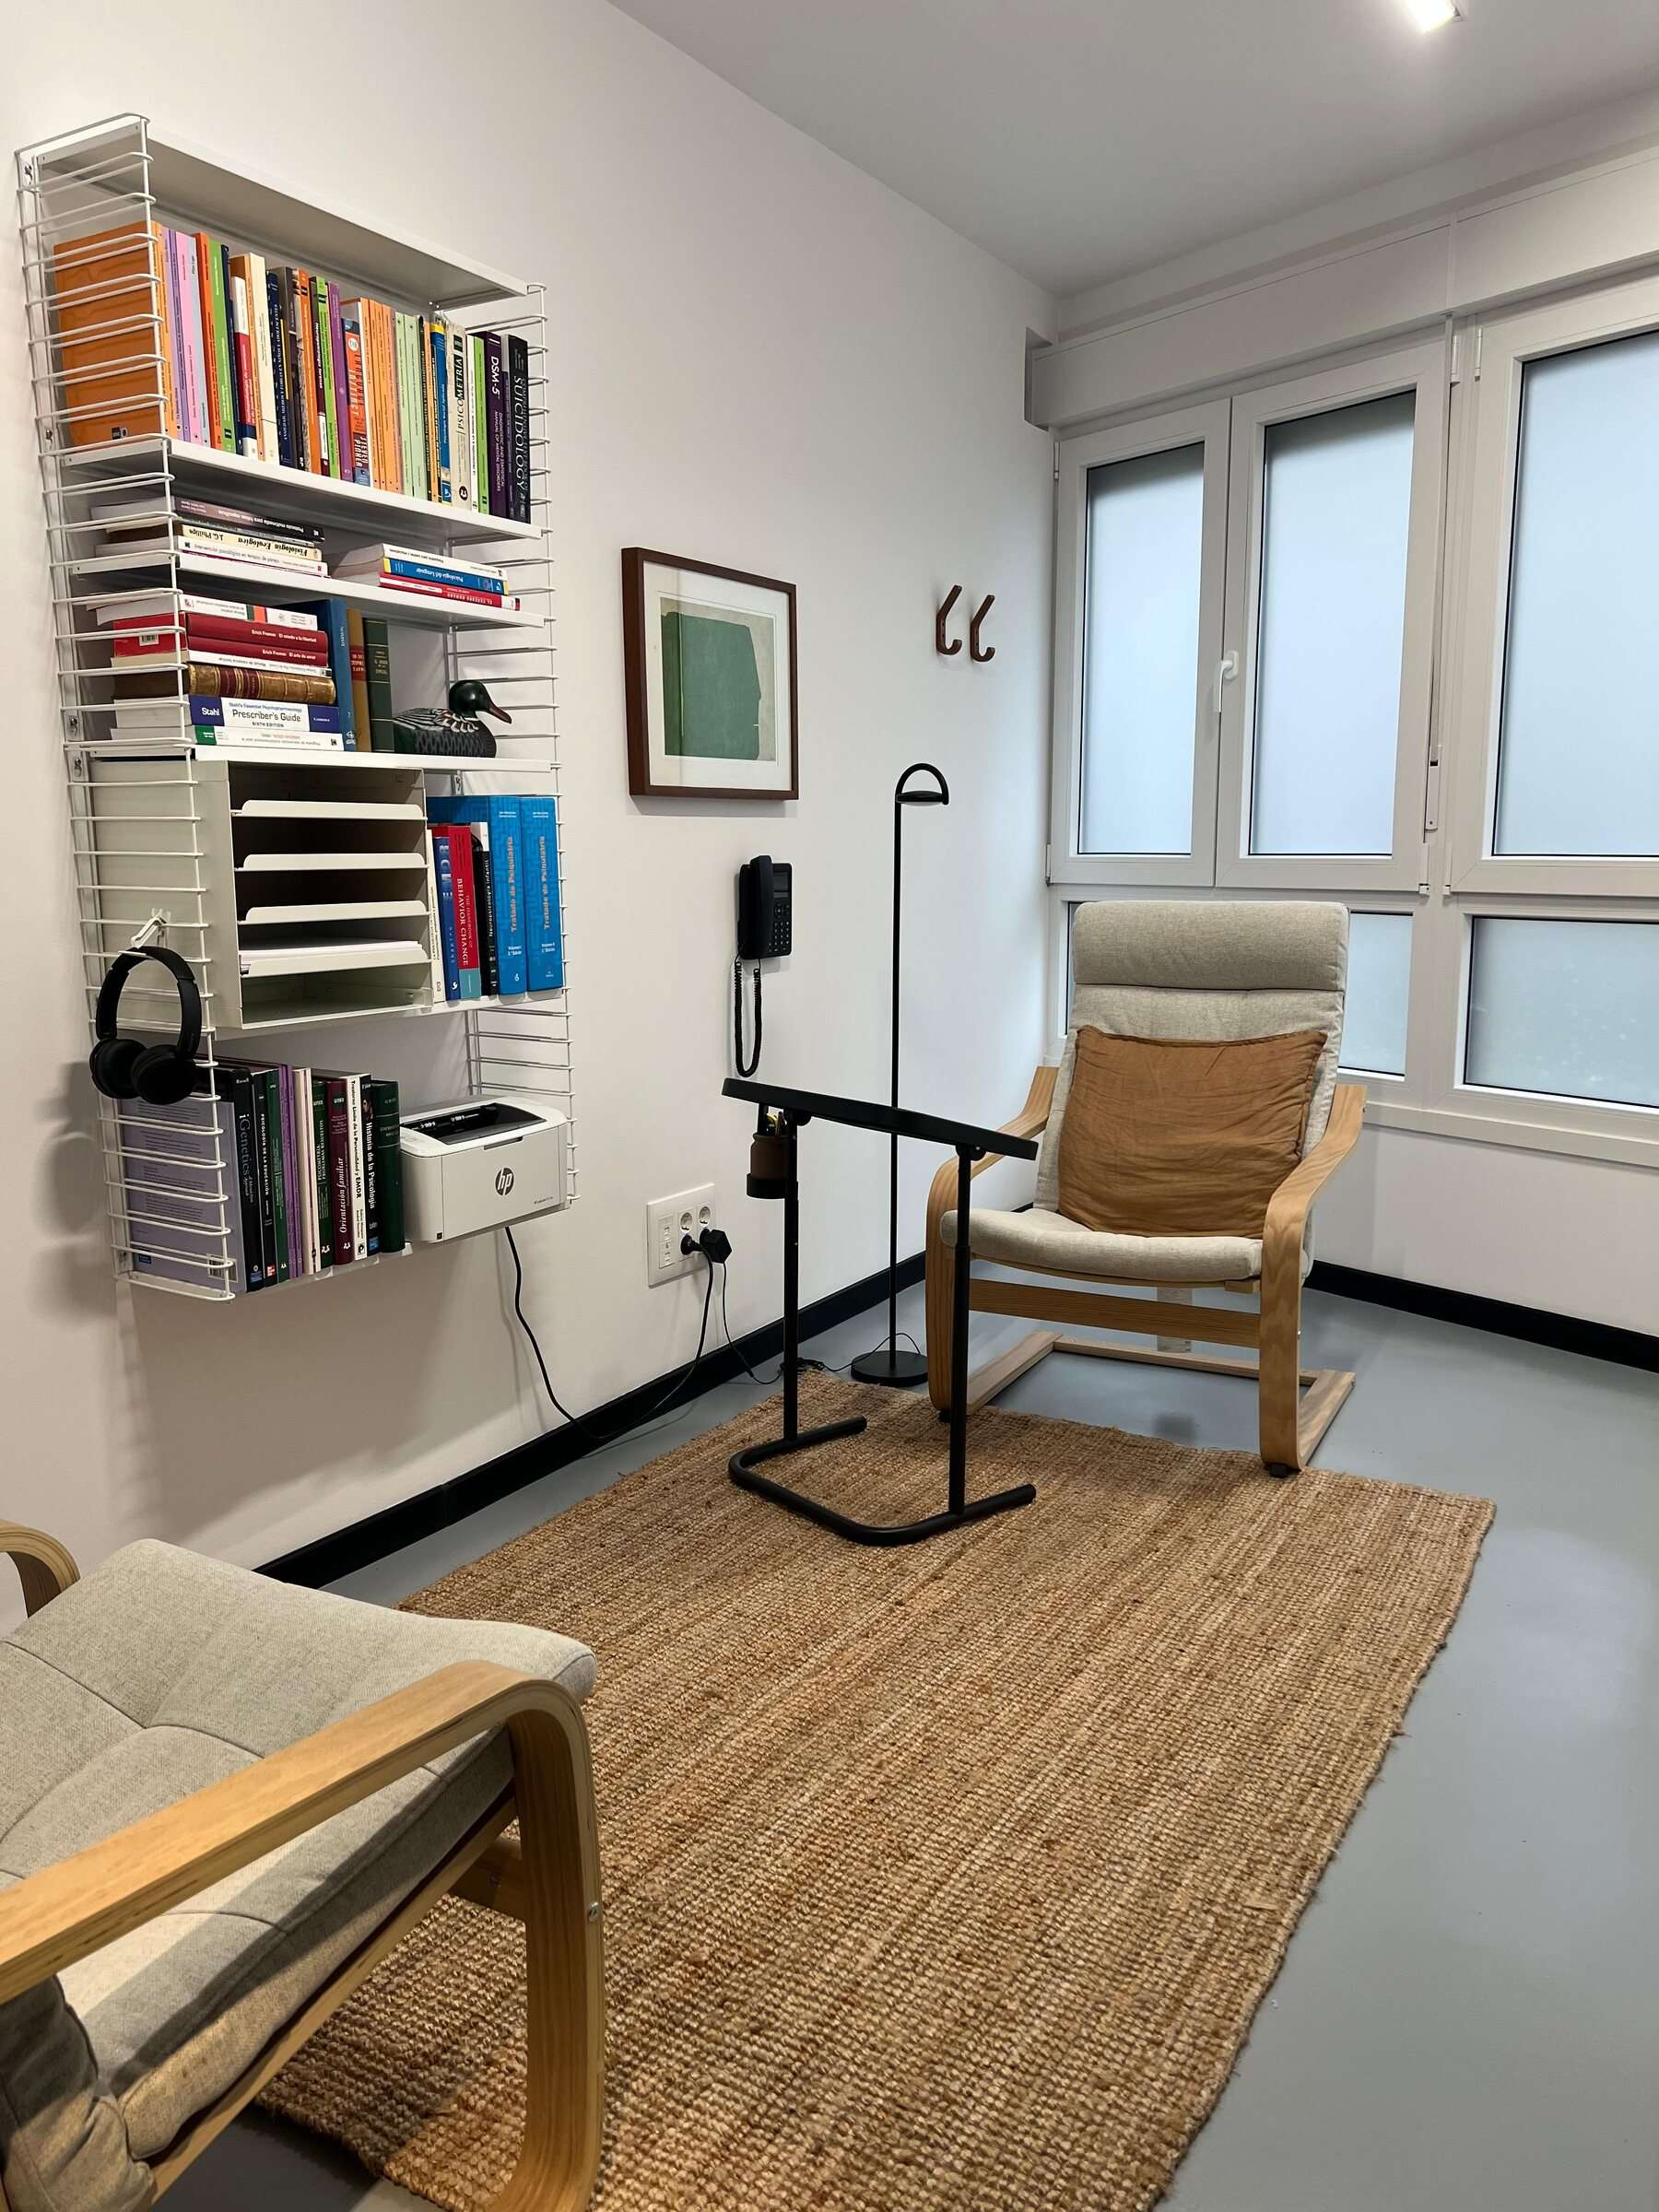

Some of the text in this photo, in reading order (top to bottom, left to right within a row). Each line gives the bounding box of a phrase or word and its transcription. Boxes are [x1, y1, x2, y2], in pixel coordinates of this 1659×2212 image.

[490, 356, 501, 394] DSM-5
[454, 356, 465, 429] PSICOMETRÍA
[514, 376, 526, 490] SUICIDOLOGY
[354, 439, 362, 467] PINKER
[359, 437, 369, 464] STEVEN
[188, 529, 211, 539] Phillips
[202, 707, 220, 716] Stahl
[232, 709, 301, 723] Prescriber's Guide
[457, 878, 466, 924] BEHAVIOR
[510, 886, 515, 896] de
[542, 884, 548, 894] de
[239, 1113, 253, 1175] iGenetics
[364, 1123, 373, 1150] Historia
[367, 1153, 374, 1161] de
[336, 1157, 347, 1189] familiar
[498, 1168, 512, 1195] hp
[367, 1172, 377, 1209] Psicología
[337, 1189, 347, 1233] Orientación
